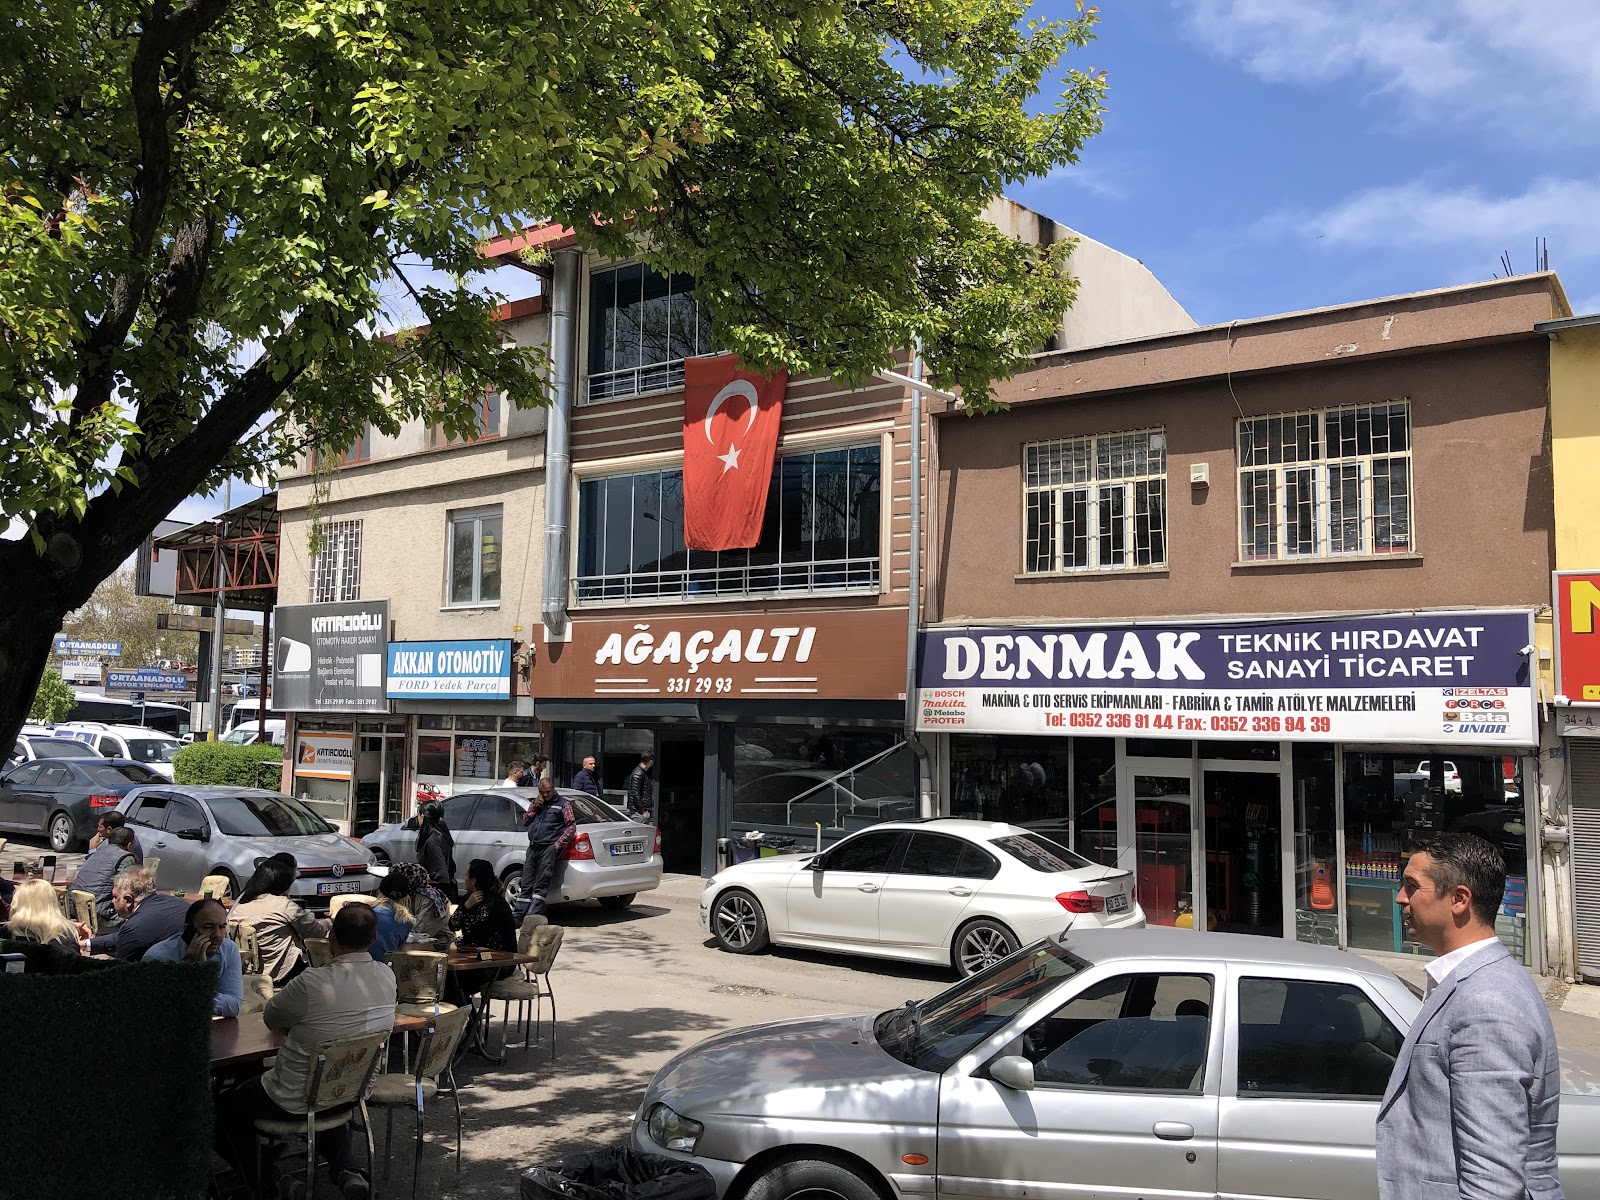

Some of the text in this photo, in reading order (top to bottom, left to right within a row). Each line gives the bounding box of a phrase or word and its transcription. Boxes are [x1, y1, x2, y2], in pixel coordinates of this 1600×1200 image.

[312, 612, 382, 632] KATIRCIOĞLU
[60, 641, 118, 650] ORTAANADOLU
[316, 636, 340, 646] OTOMOTİV
[1331, 626, 1485, 651] HIRDAVAT
[594, 624, 817, 674] AĞAÇALTI
[942, 632, 1206, 681] DENMAK
[393, 645, 504, 674] AKKAN OTOMOTİV
[1227, 654, 1475, 679] SANAYİ TİCARET
[110, 674, 184, 684] ORTAANADOLU
[398, 680, 497, 692] FORD Yedek Parça
[667, 678, 733, 693] 331 29 93
[982, 690, 1020, 708] MAKİNA
[1023, 694, 1030, 708] &
[1032, 694, 1051, 708] OTO
[1091, 690, 1162, 710] EKİPMANLARI
[1173, 692, 1221, 711] FABRİKA
[1224, 695, 1232, 711] &
[1236, 692, 1274, 712] TAMİR
[1277, 693, 1323, 712] ATÖLYE
[1326, 691, 1416, 712] MALZEMELERİ
[1448, 699, 1503, 709] FORCE
[1044, 712, 1331, 732] Tel: 0352 336 91 44 Fax: 0352 336 94 39
[1460, 712, 1507, 721] Beta
[1564, 714, 1576, 724] 34
[1586, 715, 1593, 726] A
[1459, 724, 1507, 733] UNIOR
